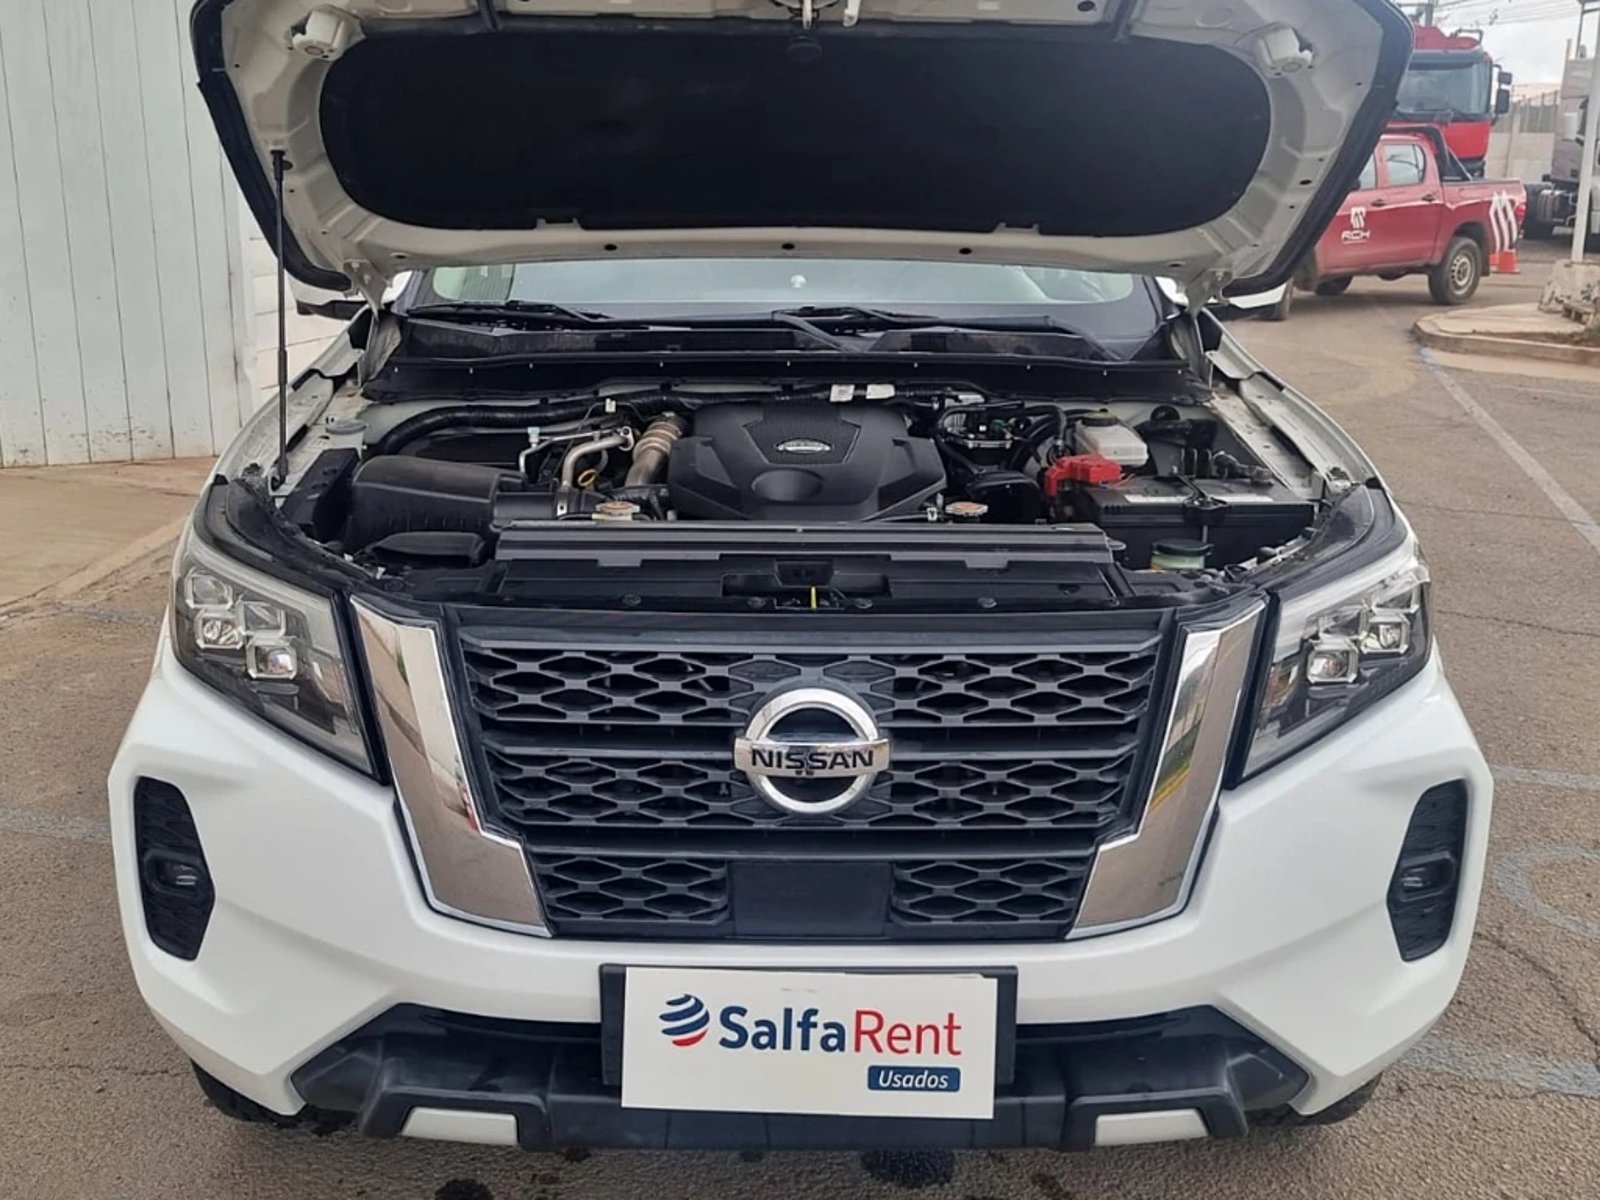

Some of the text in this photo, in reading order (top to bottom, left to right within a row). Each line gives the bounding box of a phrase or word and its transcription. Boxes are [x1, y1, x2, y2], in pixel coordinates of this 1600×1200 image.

[751, 748, 874, 770] NISSAN
[718, 1004, 962, 1056] SalfaRent
[877, 1068, 949, 1089] Usados
